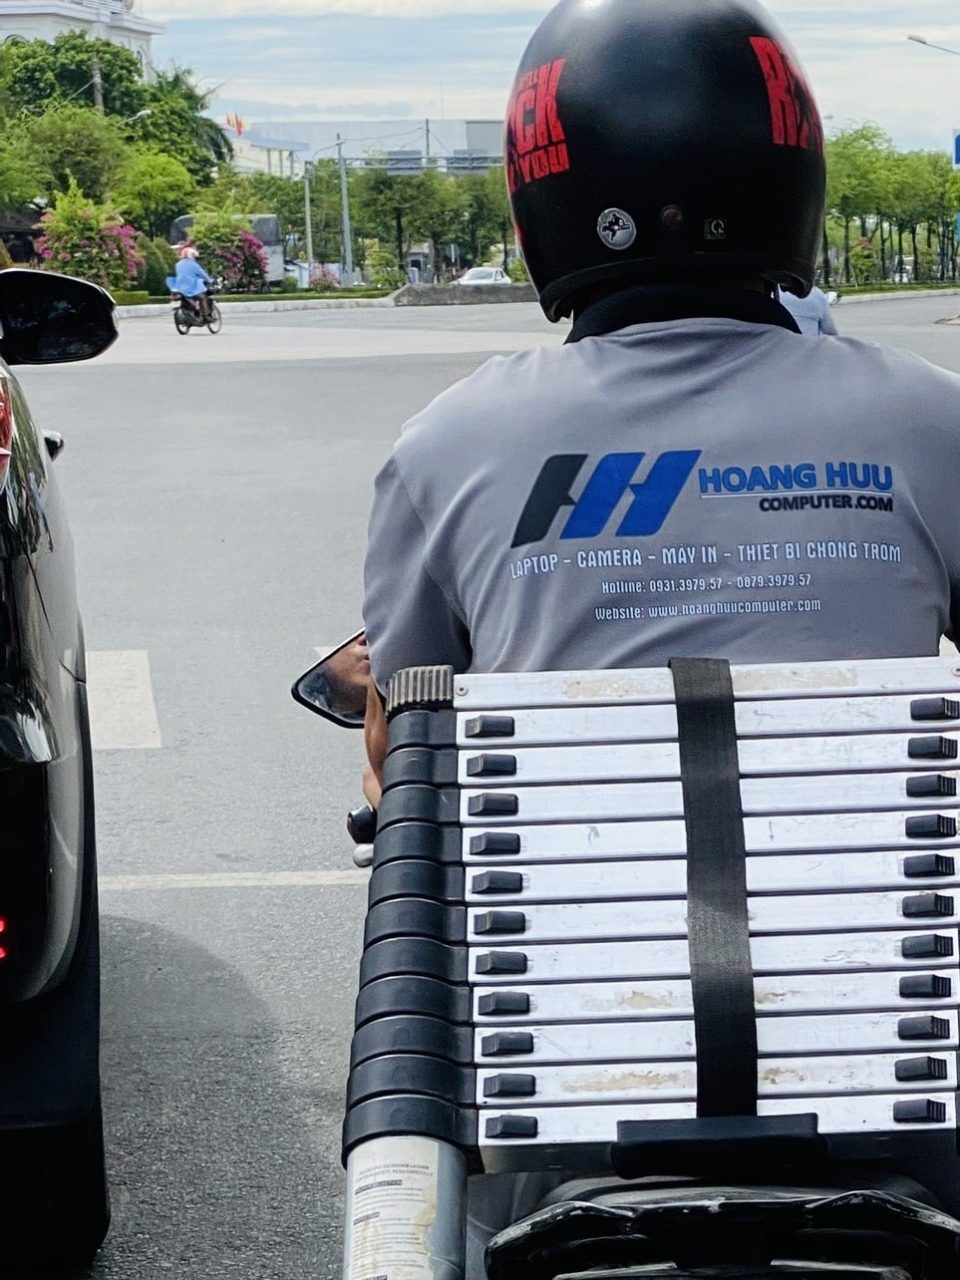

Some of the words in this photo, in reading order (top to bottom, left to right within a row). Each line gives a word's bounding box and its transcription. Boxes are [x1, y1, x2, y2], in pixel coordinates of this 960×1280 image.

[698, 463, 816, 493] HOANG
[825, 461, 893, 491] HUU
[759, 495, 893, 513] COMPUTER.COM
[510, 553, 558, 579] LAPTOP
[577, 549, 642, 568] CAMERA
[701, 546, 718, 563] IN
[602, 580, 646, 594] Hotline:
[649, 578, 722, 592] 0931.3979.57
[736, 573, 812, 588] 0879.3979.57
[595, 606, 645, 620] Website:
[649, 599, 821, 617] www.hoanghuucomputer.com
